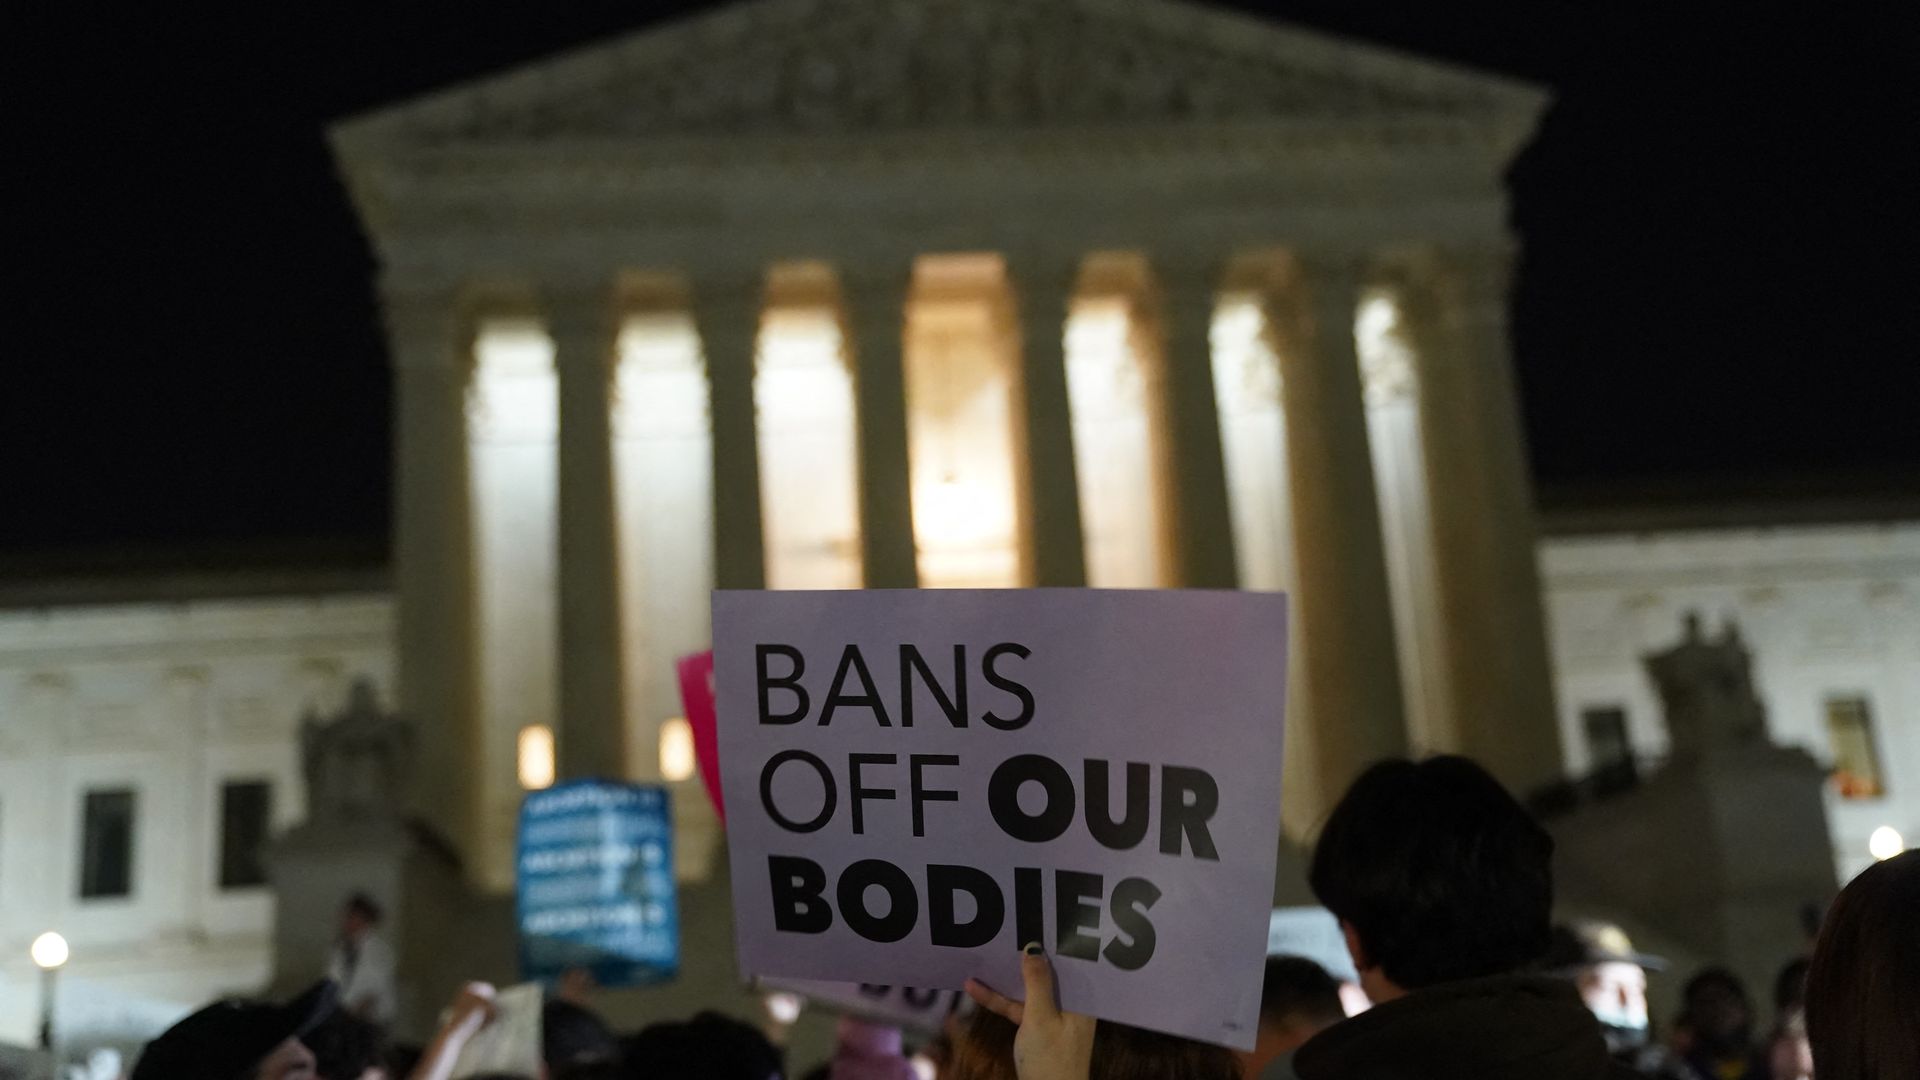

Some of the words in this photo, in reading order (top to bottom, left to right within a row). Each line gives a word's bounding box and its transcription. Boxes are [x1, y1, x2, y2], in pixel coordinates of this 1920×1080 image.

[756, 643, 1035, 730] BANS
[760, 750, 959, 837] OFF
[988, 754, 1220, 861] OUR
[768, 855, 1162, 971] BODIES
